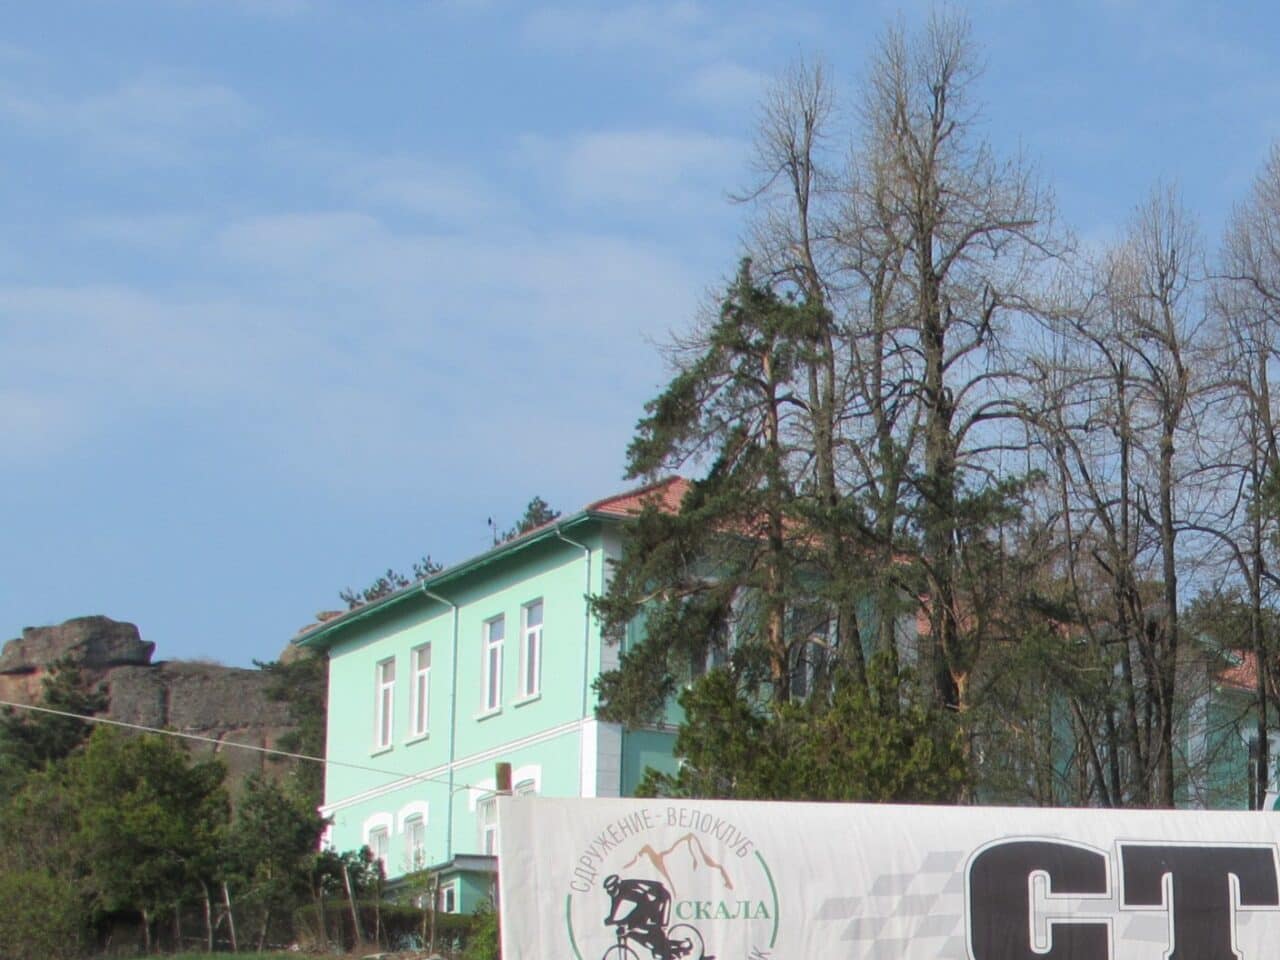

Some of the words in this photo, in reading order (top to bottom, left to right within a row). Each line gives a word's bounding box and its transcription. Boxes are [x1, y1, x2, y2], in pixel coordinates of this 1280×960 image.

[569, 808, 655, 893] СДРУЖЕНИЕ
[667, 807, 754, 858] ВЕЛОКЛУБ
[675, 900, 770, 920] СКАЛА
